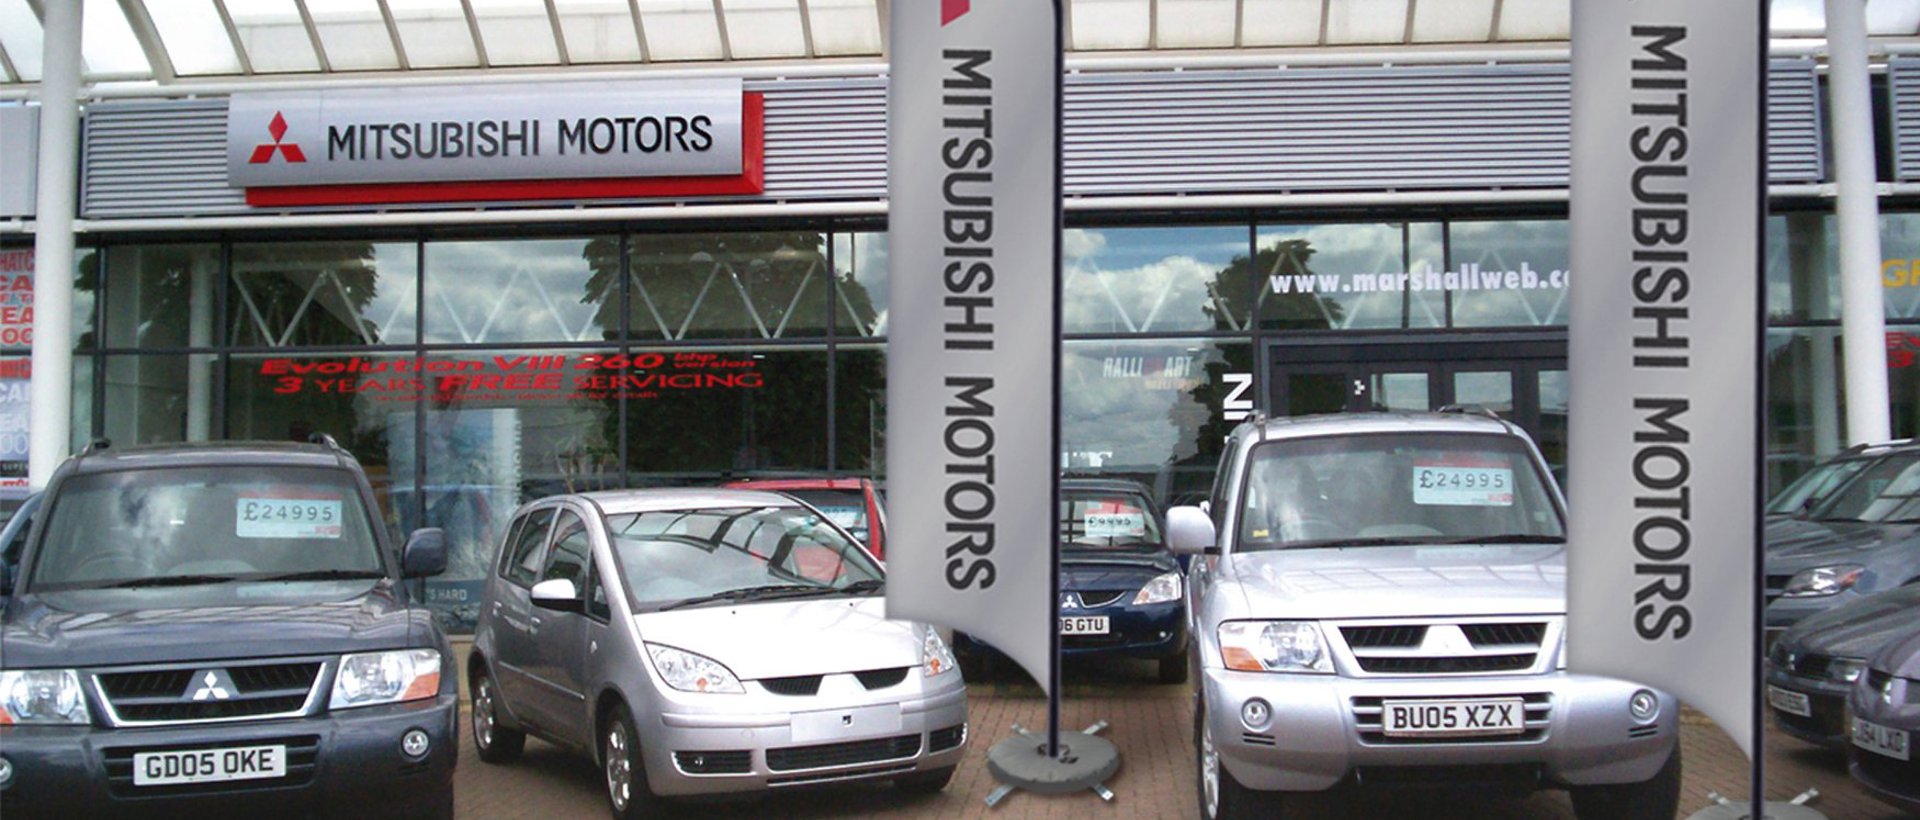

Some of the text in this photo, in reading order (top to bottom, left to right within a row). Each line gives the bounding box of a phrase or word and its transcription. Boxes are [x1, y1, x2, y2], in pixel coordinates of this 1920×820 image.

[327, 115, 714, 162] MITSUBISHI MOTORS
[941, 49, 996, 591] MITSUBISHI MOTORS
[1631, 25, 1692, 641] MITSUBISHI MOTORS
[260, 356, 485, 375] Evolution
[493, 354, 567, 371] VIII
[573, 352, 665, 370] 260
[673, 359, 756, 369] version
[272, 372, 765, 394] 3 YEARS FREE SERVICING
[1419, 469, 1505, 489] £24995
[243, 502, 333, 521] £24995
[1076, 618, 1105, 632] GTU
[1392, 704, 1513, 729] BU05 XZX
[146, 748, 274, 779] GD05 OKE
